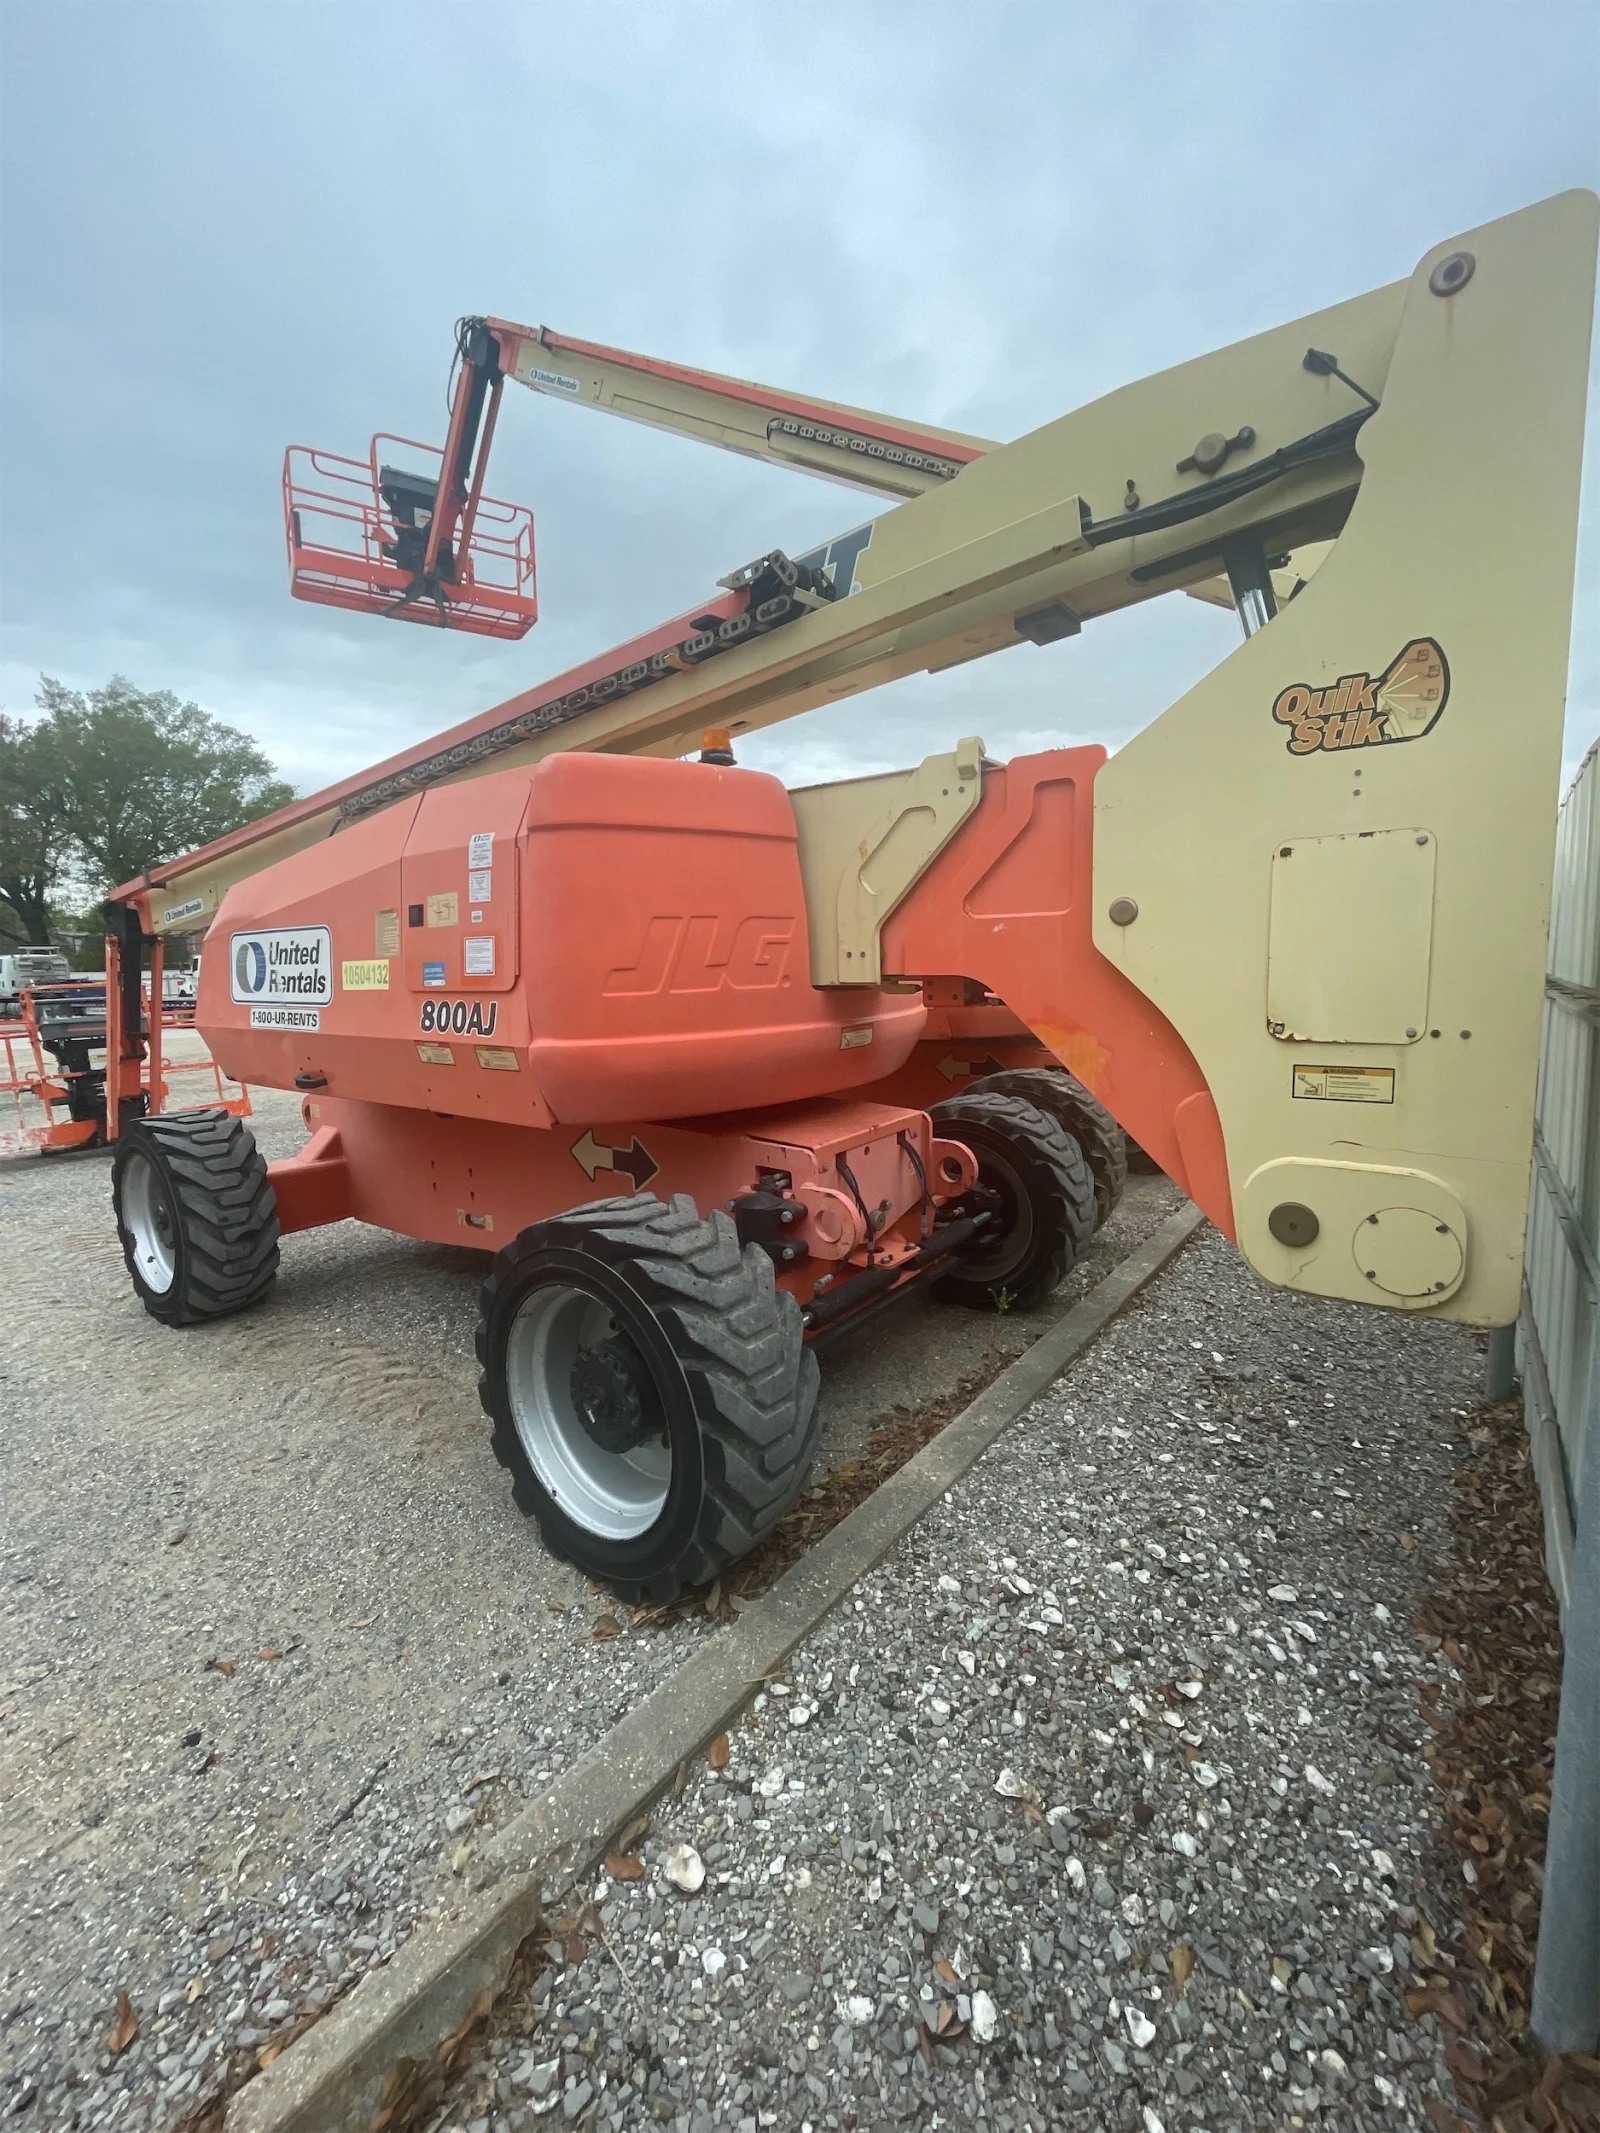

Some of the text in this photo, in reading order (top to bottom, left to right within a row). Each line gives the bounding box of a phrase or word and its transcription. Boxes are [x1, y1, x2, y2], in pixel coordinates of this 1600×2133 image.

[537, 371, 578, 391] United Rentals
[1275, 676, 1381, 724] Quik
[1289, 709, 1388, 752] Stik
[268, 938, 321, 966] United
[602, 914, 796, 997] JLG
[268, 968, 326, 994] Rentals
[344, 963, 388, 985] 10504132
[252, 1010, 318, 1027] 1-800-UR-RENTS
[420, 1000, 497, 1036] 800AJ
[1329, 1068, 1366, 1076] WARNING
